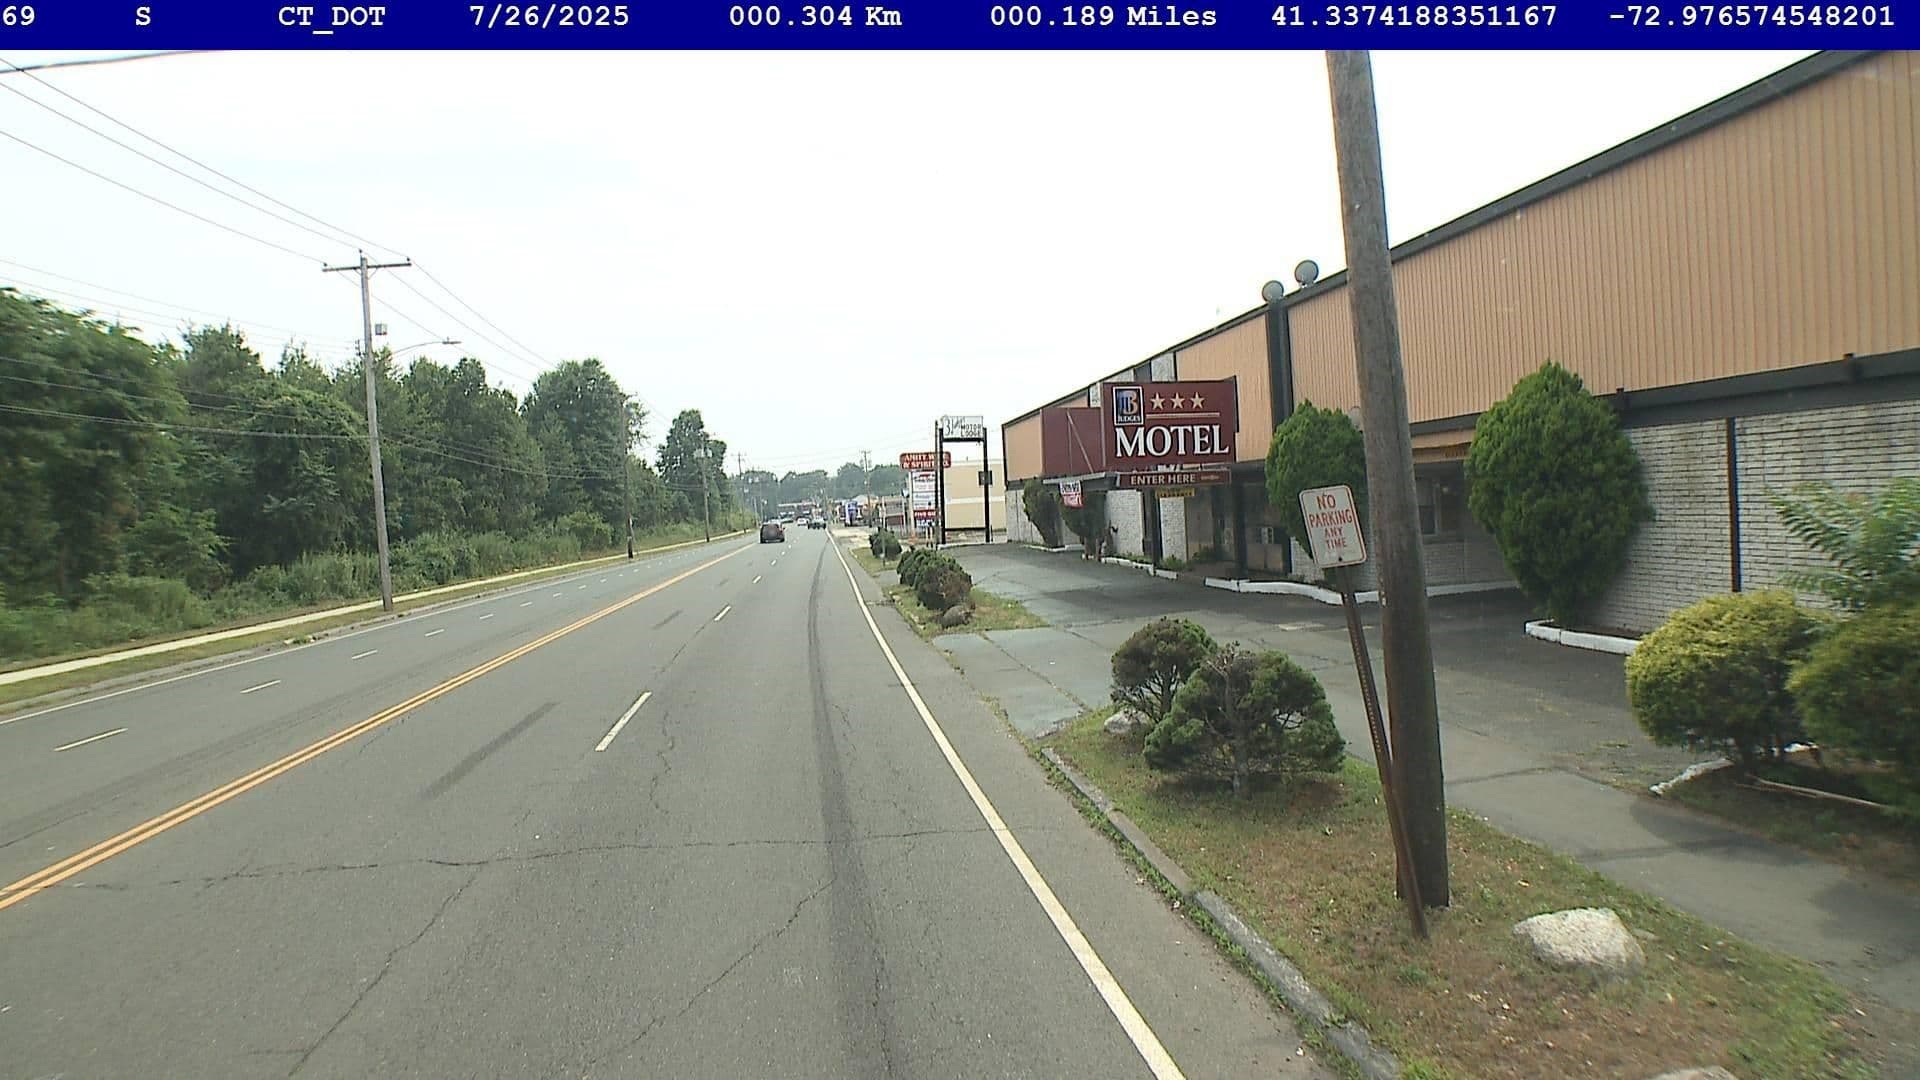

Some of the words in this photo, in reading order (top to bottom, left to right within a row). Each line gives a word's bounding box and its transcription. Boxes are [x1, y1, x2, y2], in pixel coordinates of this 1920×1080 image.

[1115, 424, 1230, 458] MOTEL
[1130, 475, 1165, 485] ENTER
[1167, 473, 1196, 484] HERE
[1316, 494, 1336, 510] NO
[1309, 509, 1353, 528] PARKING
[1324, 526, 1343, 538] ANY
[1325, 537, 1348, 549] TIME
